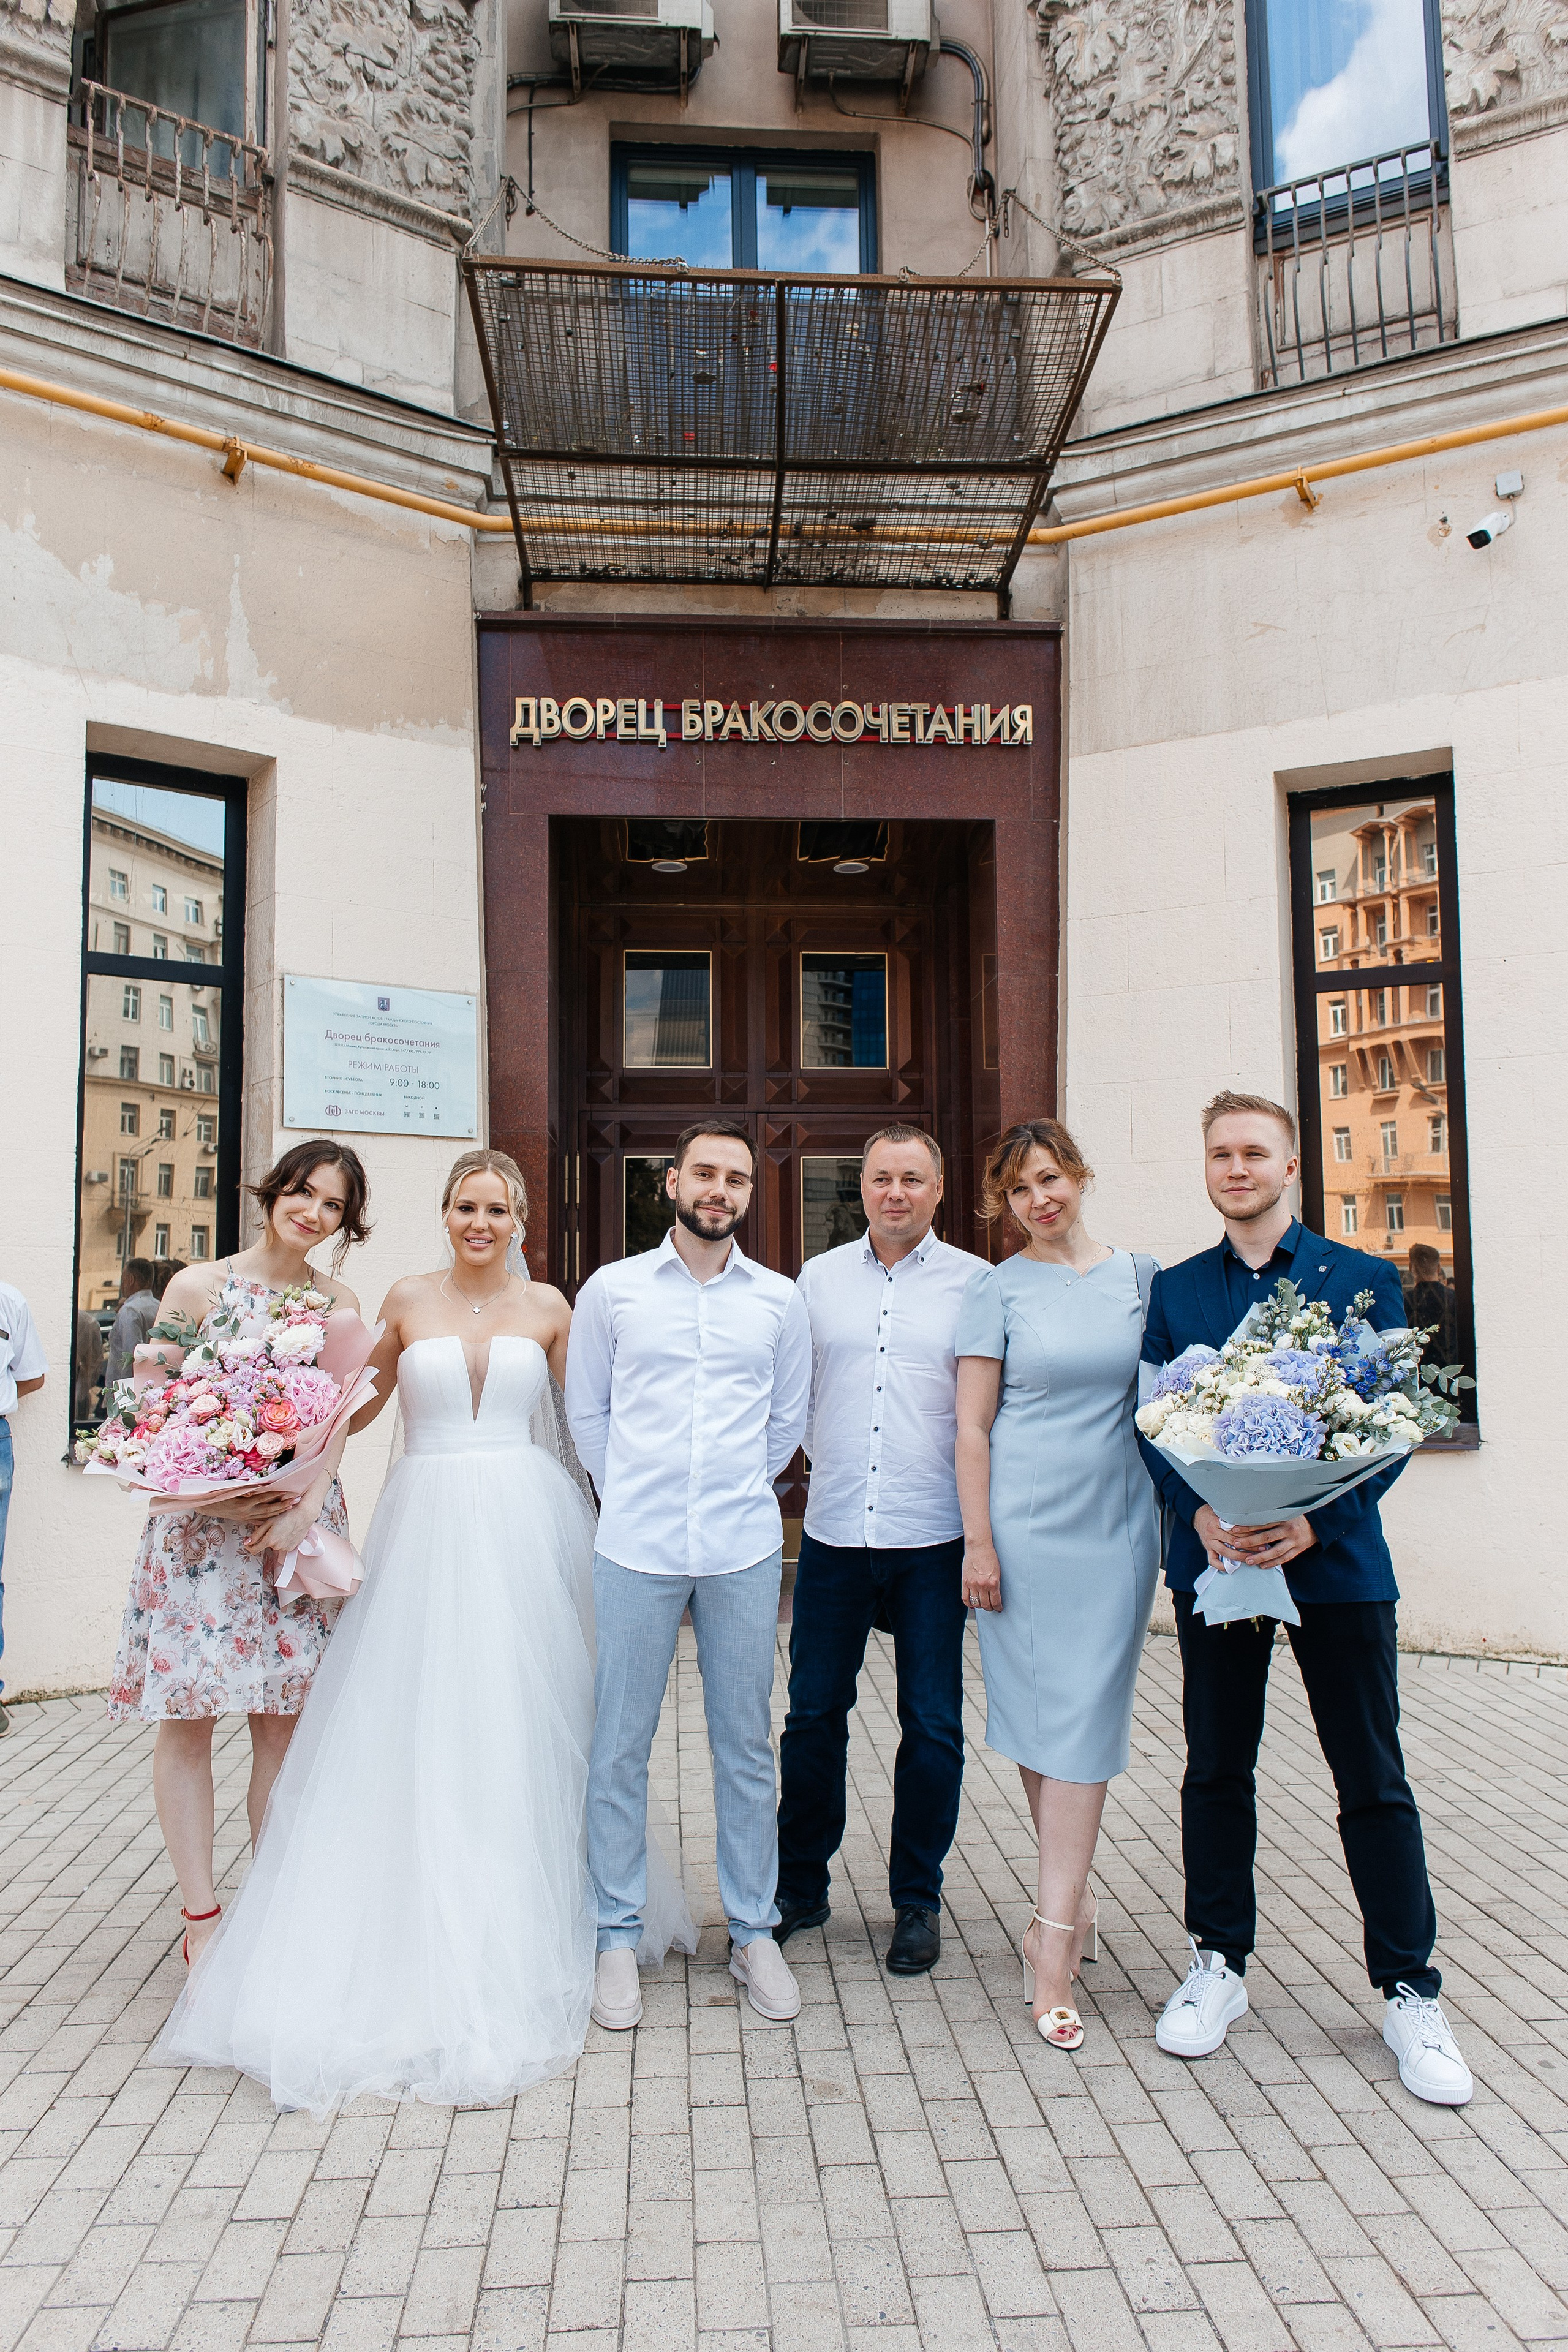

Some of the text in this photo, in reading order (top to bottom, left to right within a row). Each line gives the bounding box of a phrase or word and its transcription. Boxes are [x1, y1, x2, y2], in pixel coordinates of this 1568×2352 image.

[510, 697, 1034, 747] ДВОРЕЦ БРАКОСОЧЕТАНИЯ
[325, 1029, 362, 1042] Дворец
[364, 1033, 440, 1048] бракосочетания
[348, 1060, 418, 1074] РЕЖИМ РАБОТЫ
[389, 1078, 409, 1087] 9:00
[418, 1080, 440, 1090] 18:00
